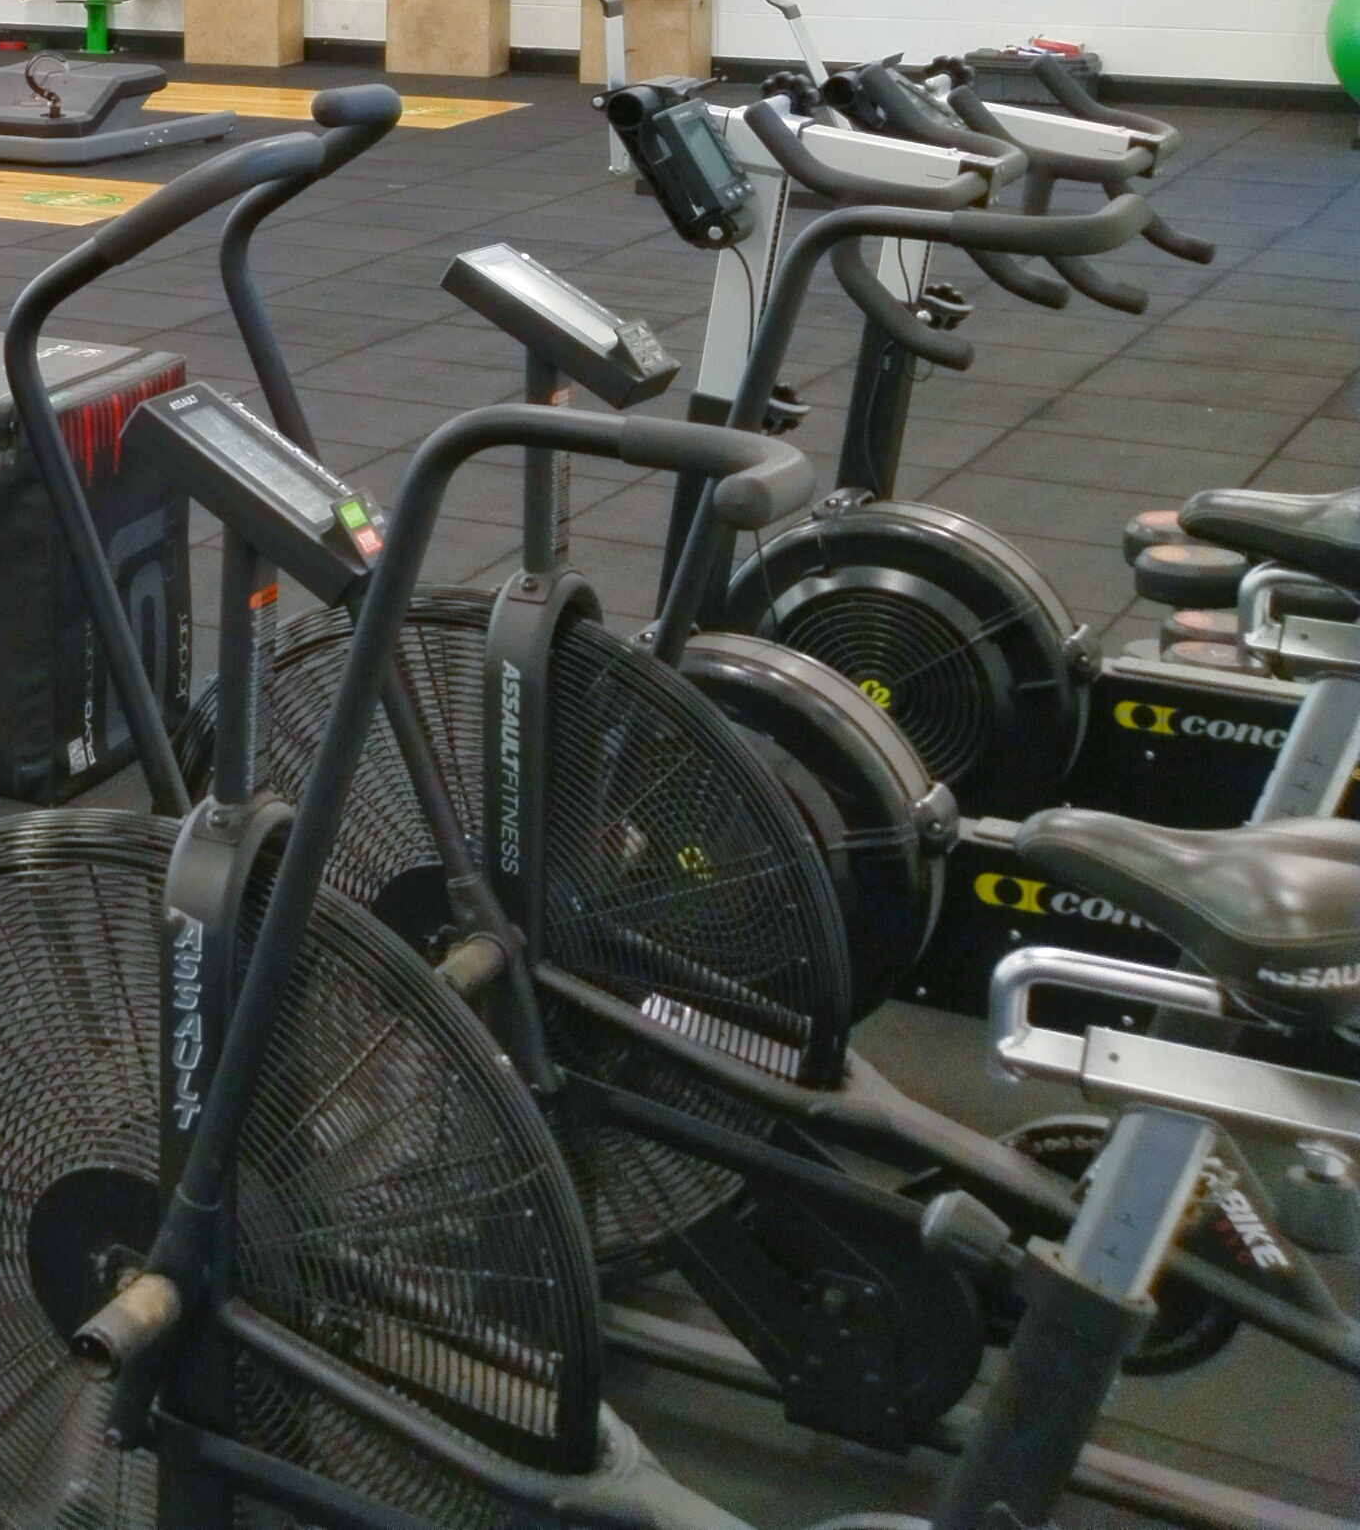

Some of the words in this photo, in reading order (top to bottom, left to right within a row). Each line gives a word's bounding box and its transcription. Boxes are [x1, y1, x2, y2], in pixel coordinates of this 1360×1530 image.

[169, 394, 198, 411] ASSAULT
[1050, 891, 1160, 932] con
[172, 922, 204, 1131] ASSAULT
